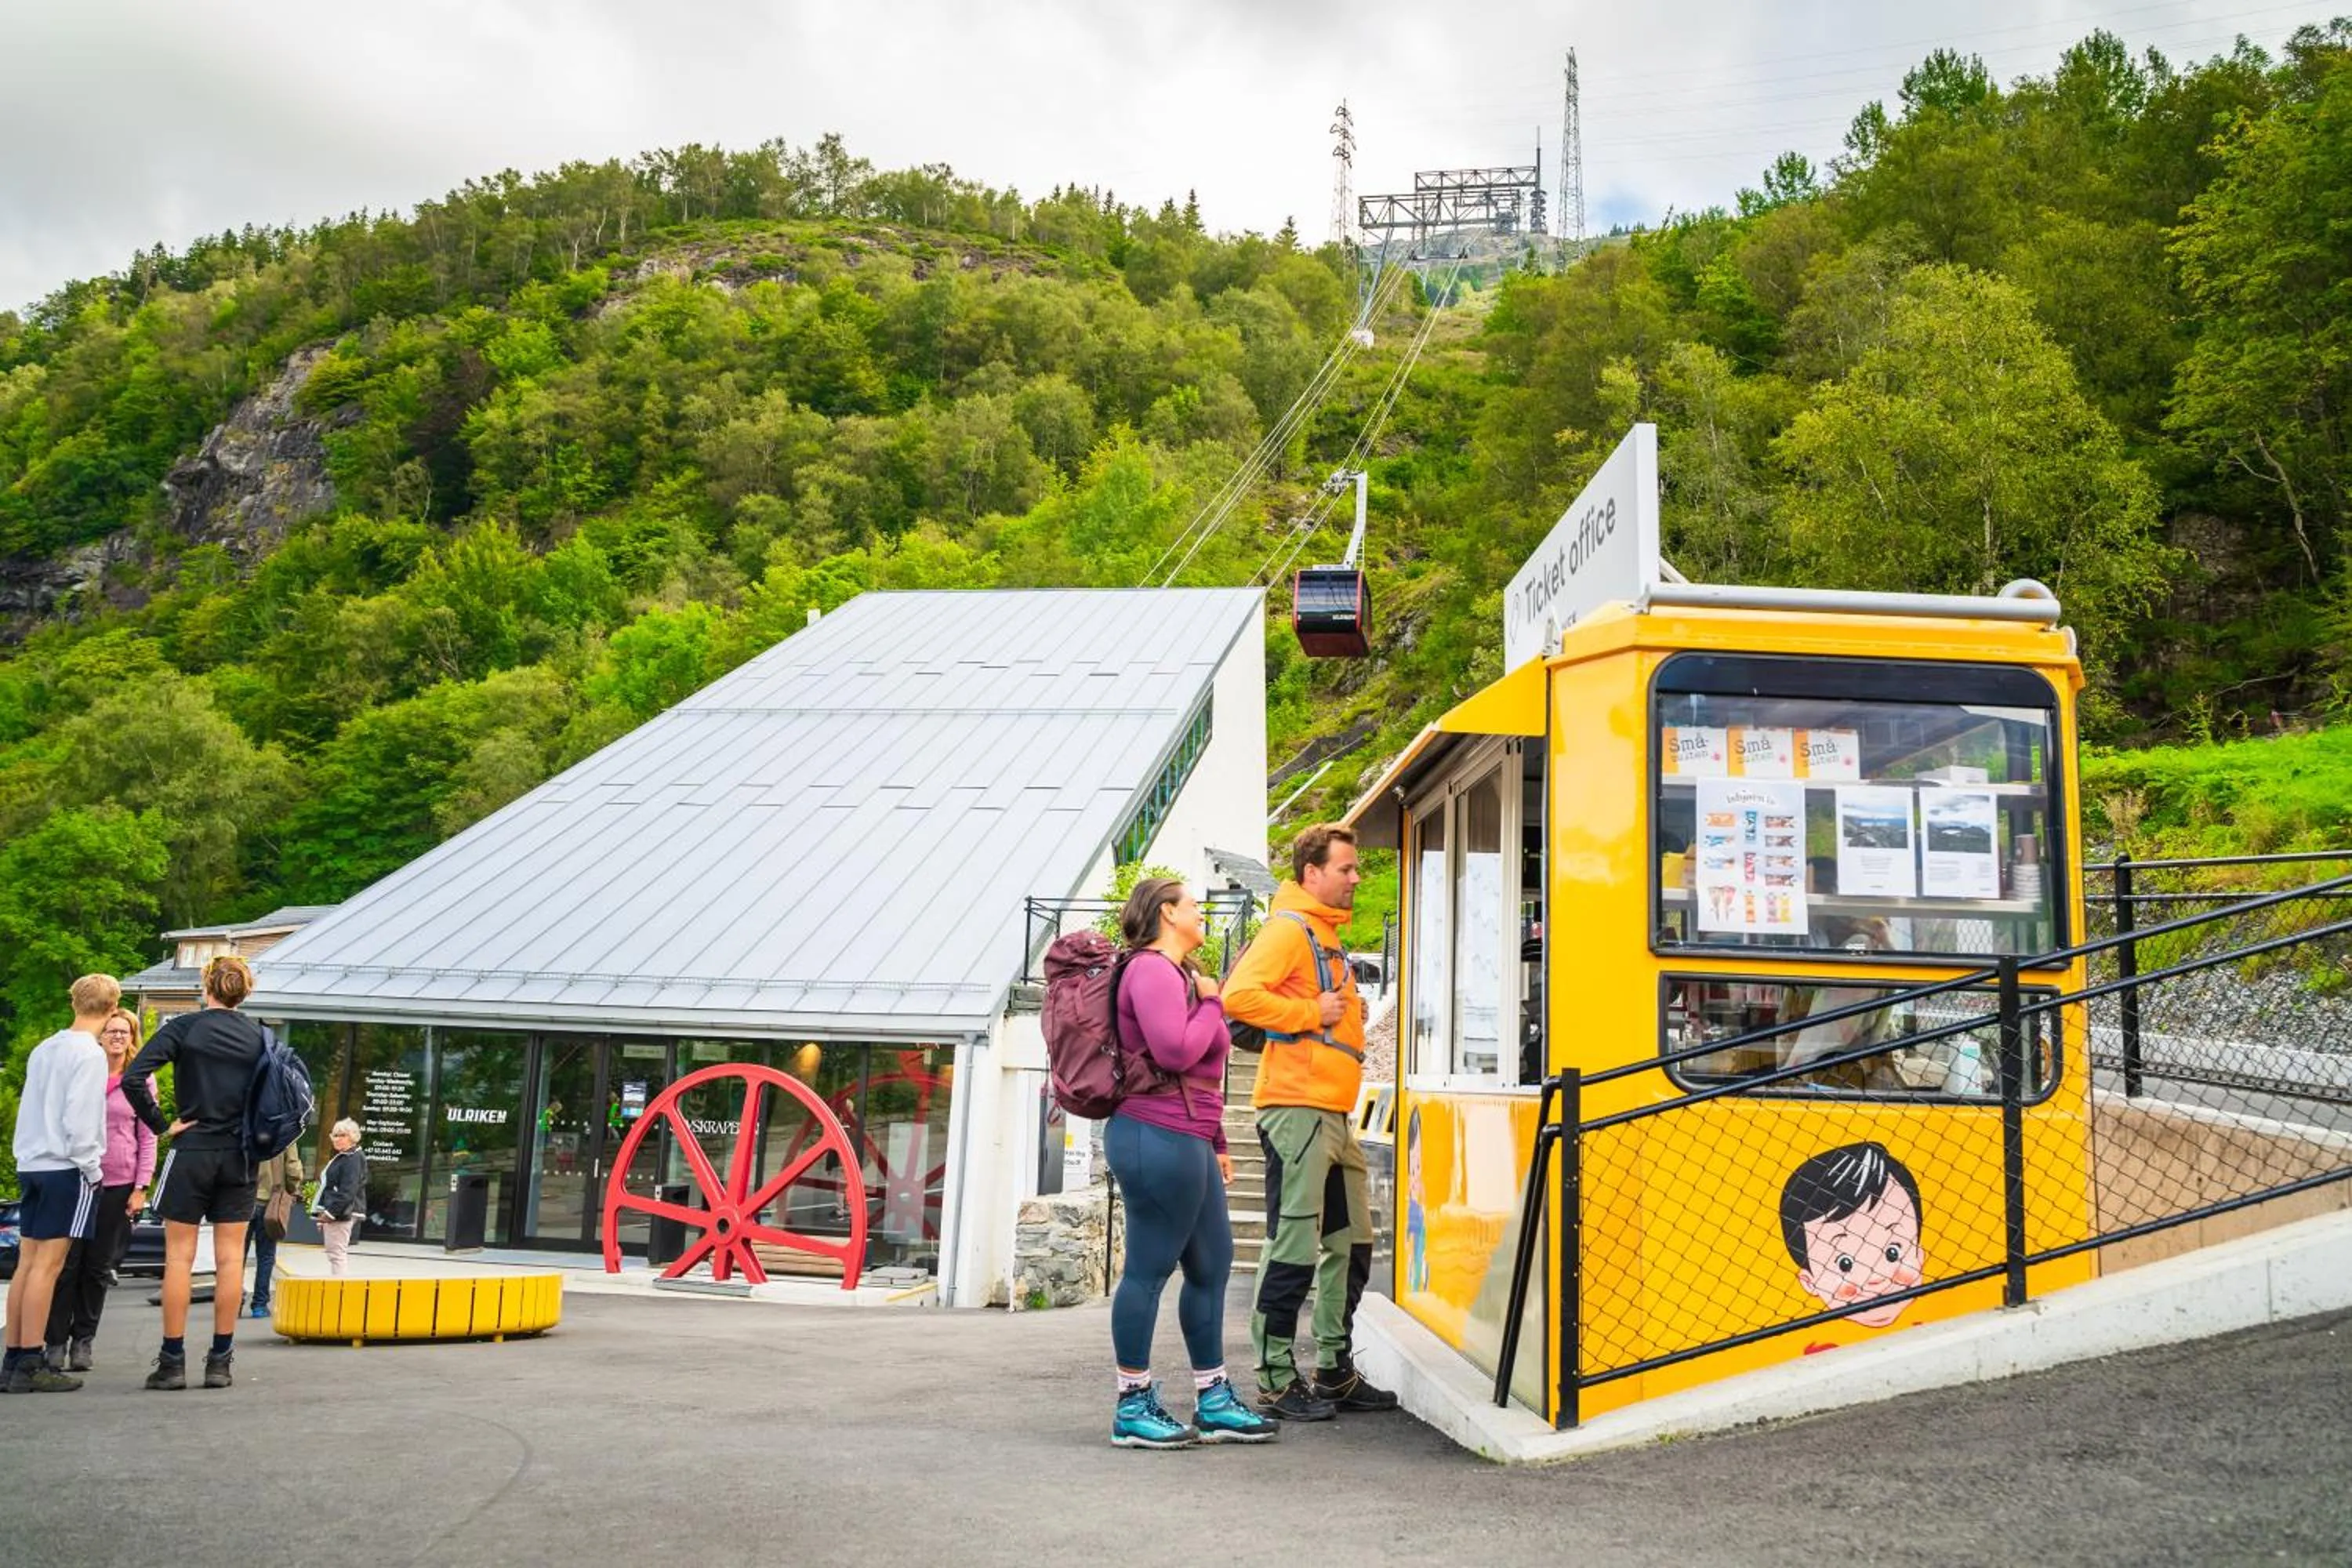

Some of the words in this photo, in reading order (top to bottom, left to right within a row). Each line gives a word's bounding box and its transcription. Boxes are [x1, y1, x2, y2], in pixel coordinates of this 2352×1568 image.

[1525, 545, 1566, 622] Ticket
[1569, 496, 1617, 575] office
[447, 1108, 507, 1123] ULRIKEN
